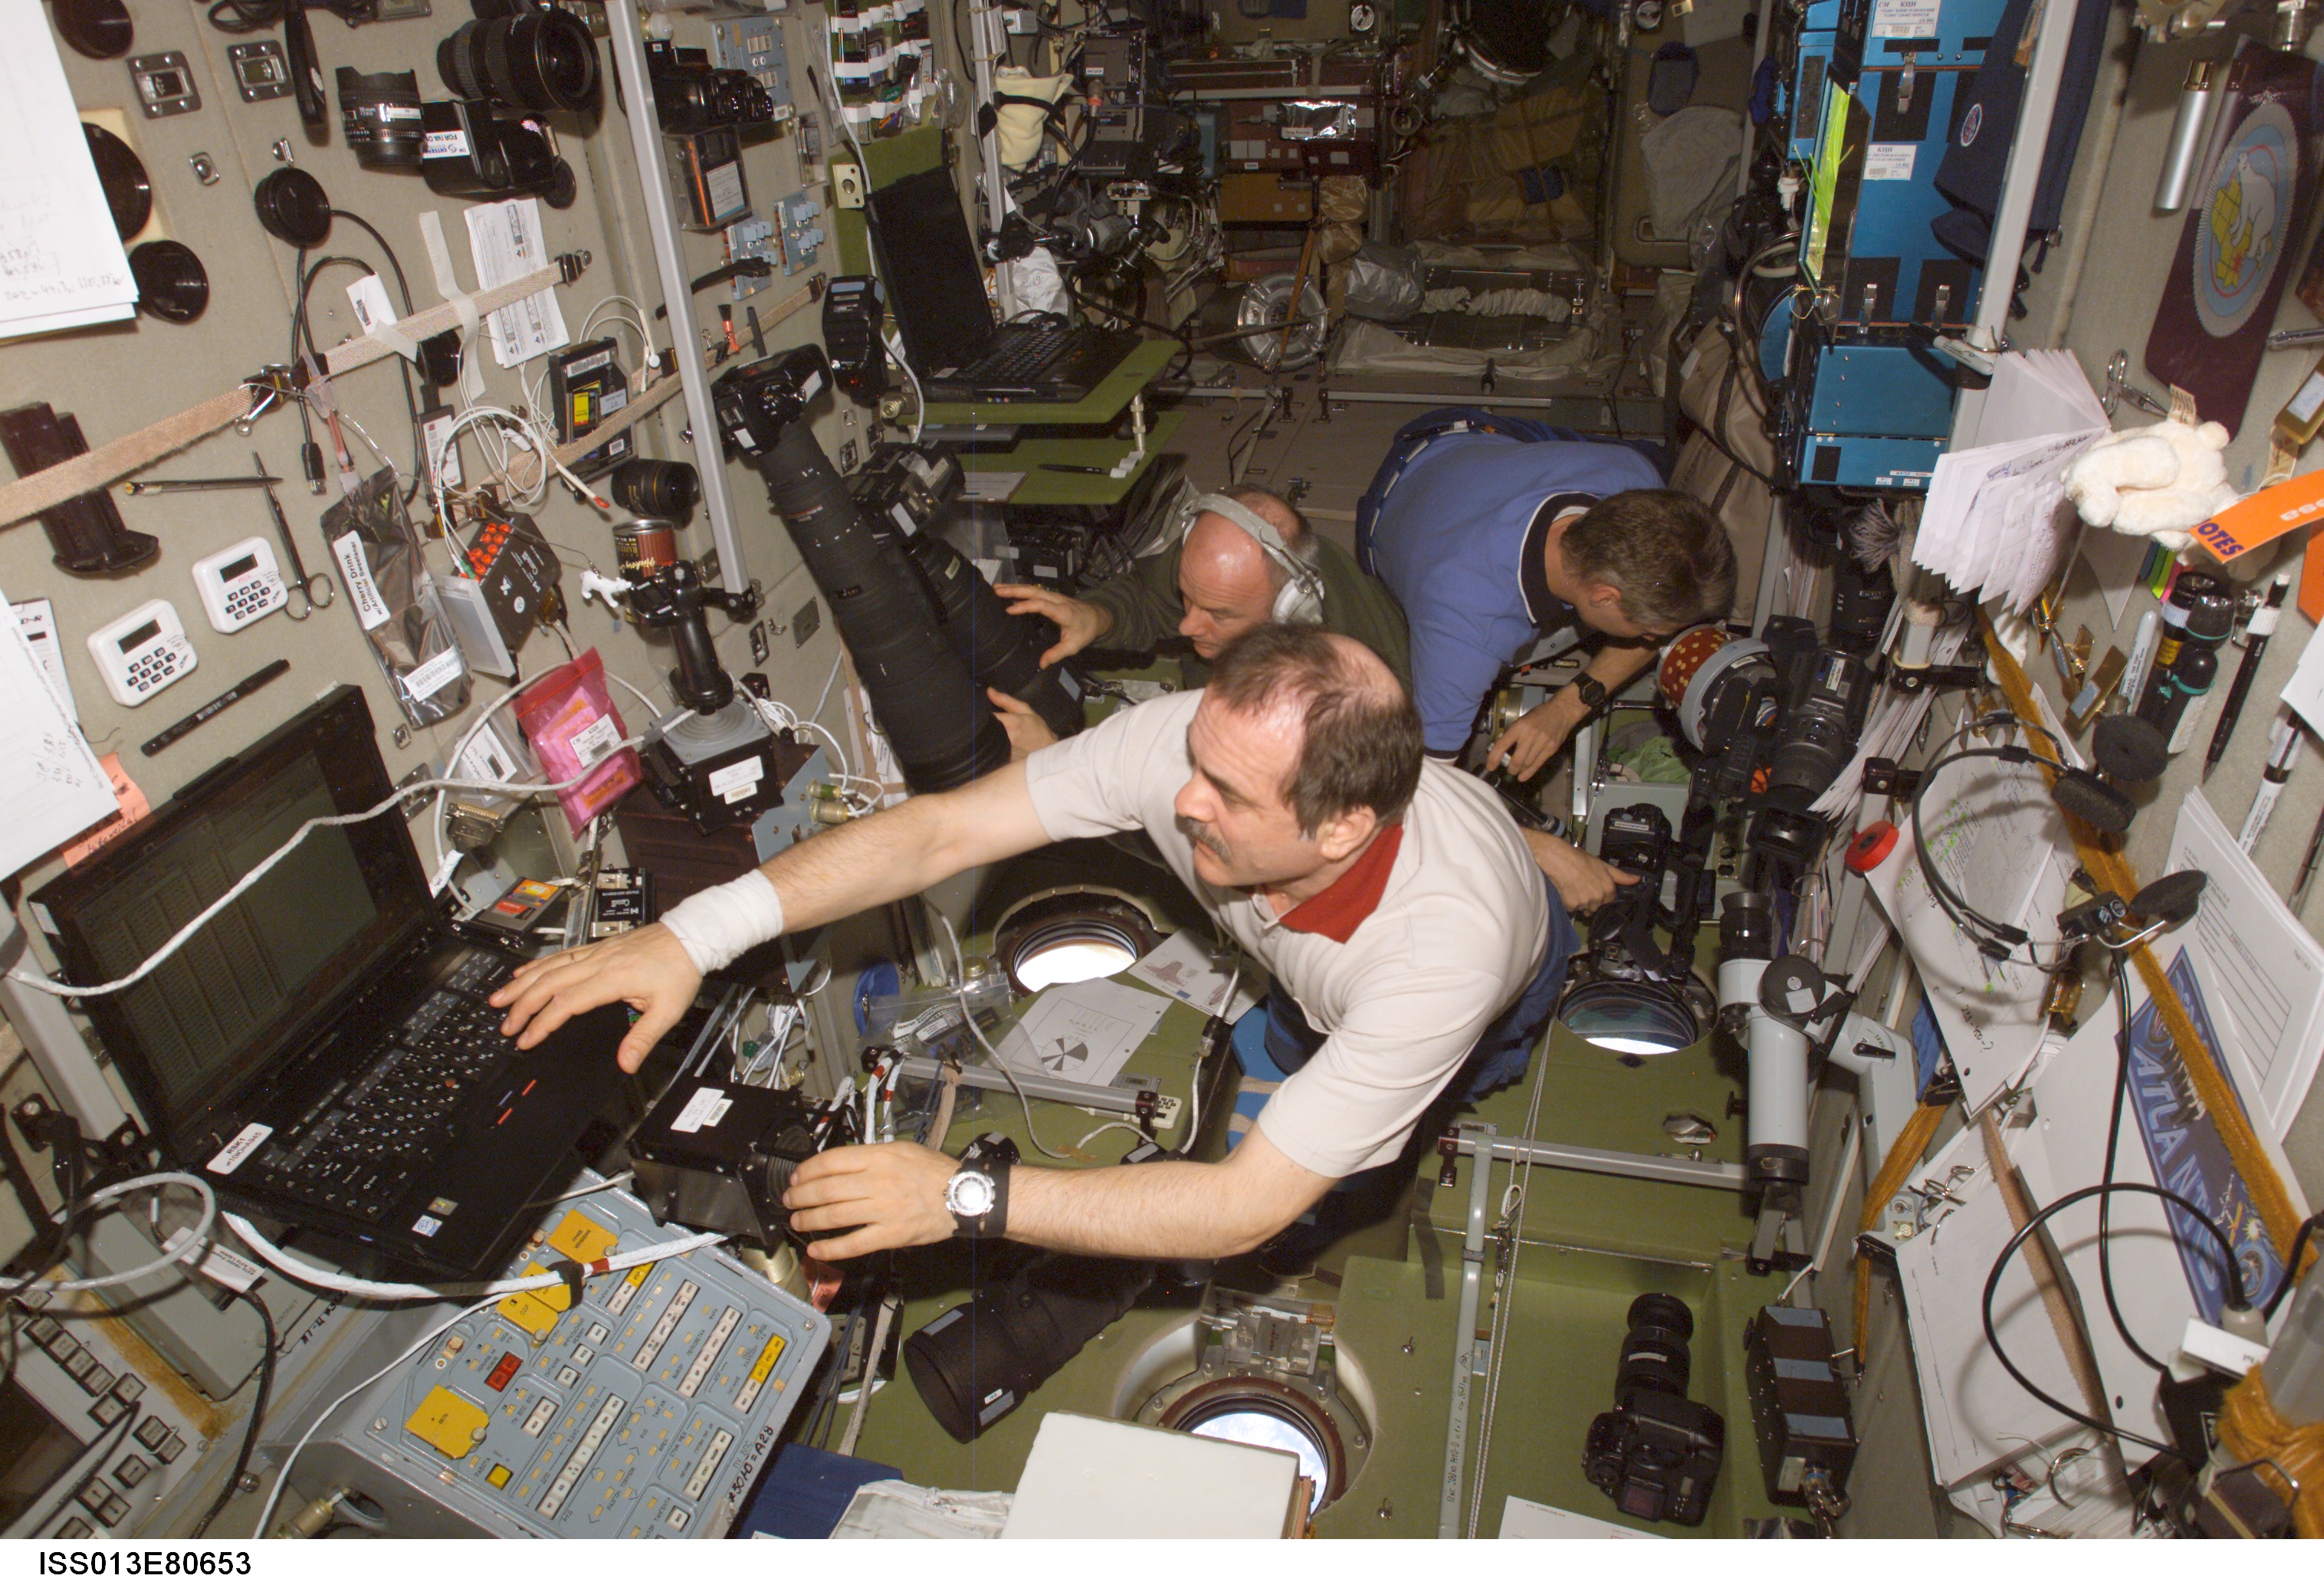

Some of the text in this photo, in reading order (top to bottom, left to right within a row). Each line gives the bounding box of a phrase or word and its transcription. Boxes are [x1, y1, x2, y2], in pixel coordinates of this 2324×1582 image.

[2198, 519, 2244, 556] OTES
[350, 541, 366, 576] Sweetener
[344, 553, 371, 612] Cherry Drink
[474, 1456, 491, 1478] РАБОТА
